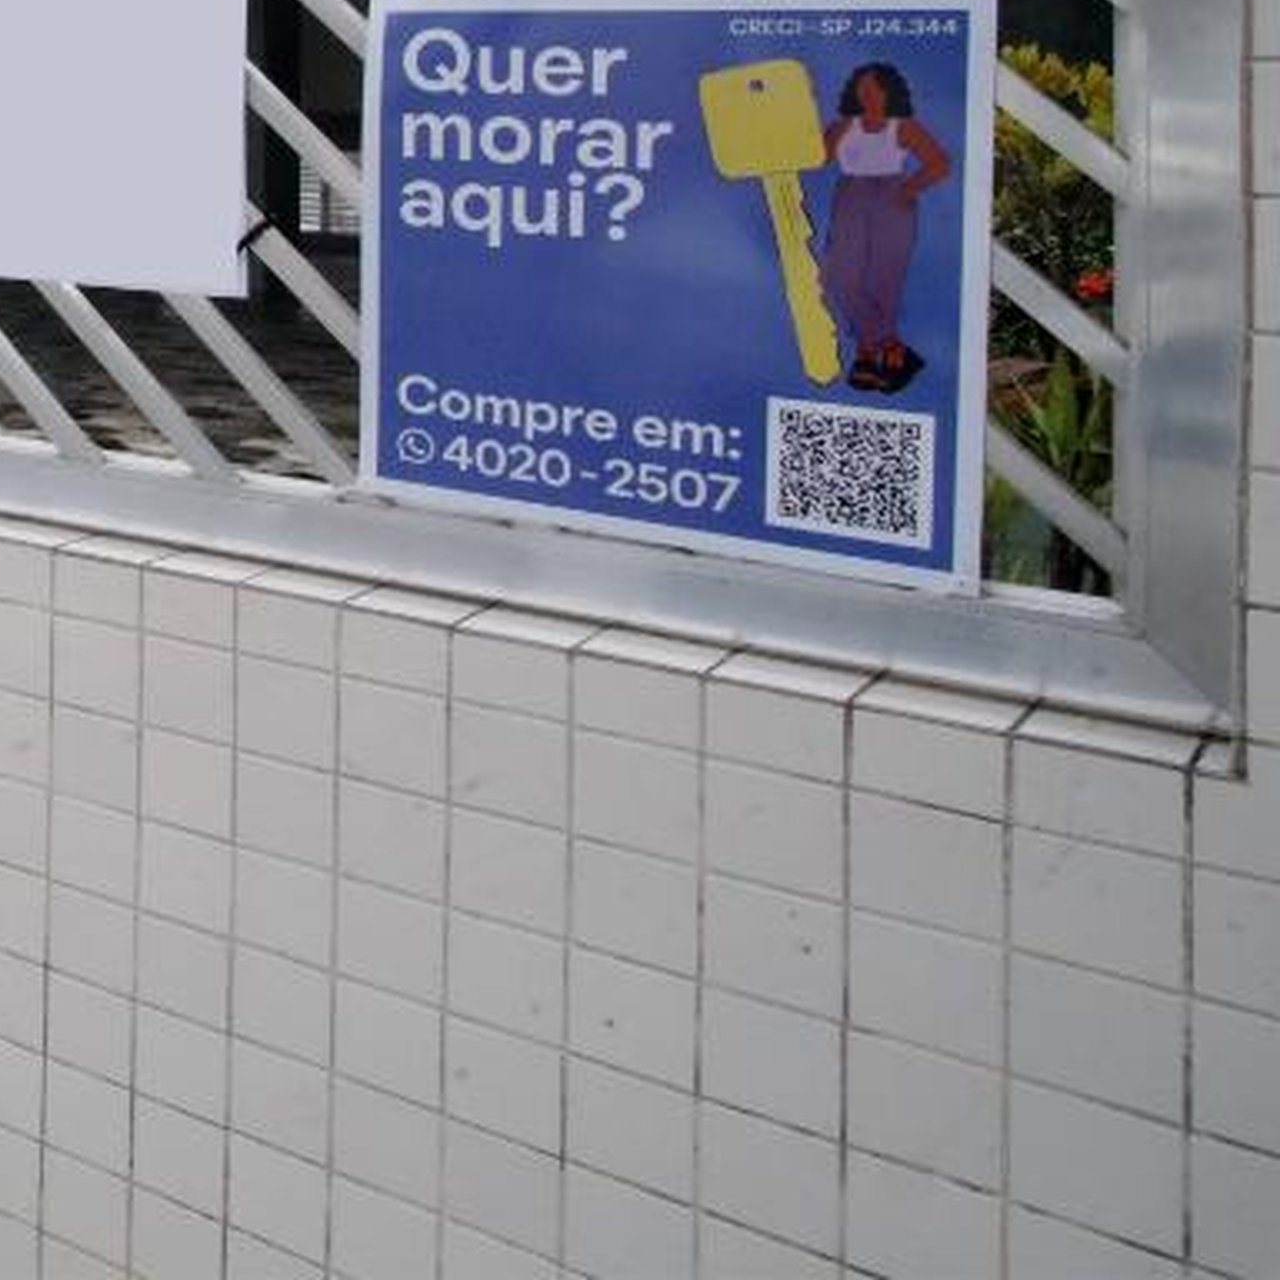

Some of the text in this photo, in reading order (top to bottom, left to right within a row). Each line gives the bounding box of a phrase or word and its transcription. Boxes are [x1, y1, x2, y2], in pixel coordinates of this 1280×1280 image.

[402, 28, 628, 95] Quer
[401, 112, 673, 170] morar
[399, 171, 645, 248] aqui?
[397, 374, 742, 460] Compre em:
[442, 435, 742, 513] 4020-2507
